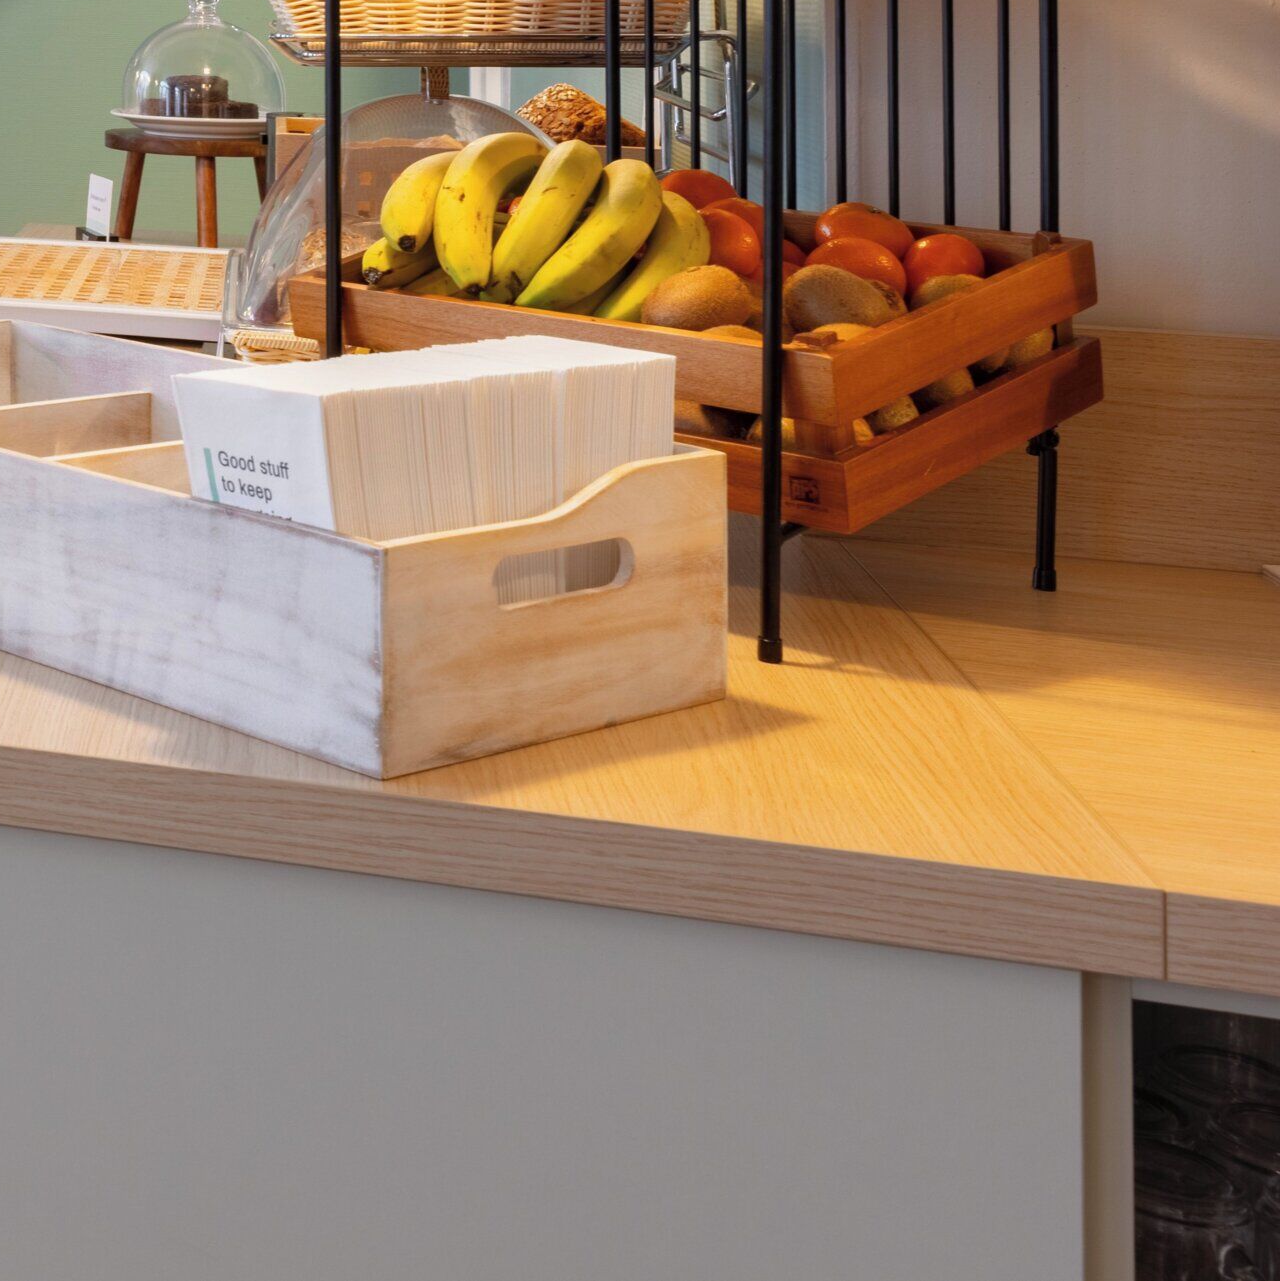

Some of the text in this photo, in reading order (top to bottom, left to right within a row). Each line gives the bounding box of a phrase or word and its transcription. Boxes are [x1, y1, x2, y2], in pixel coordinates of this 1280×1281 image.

[218, 451, 289, 479] Good stuff
[221, 476, 272, 503] to keep
